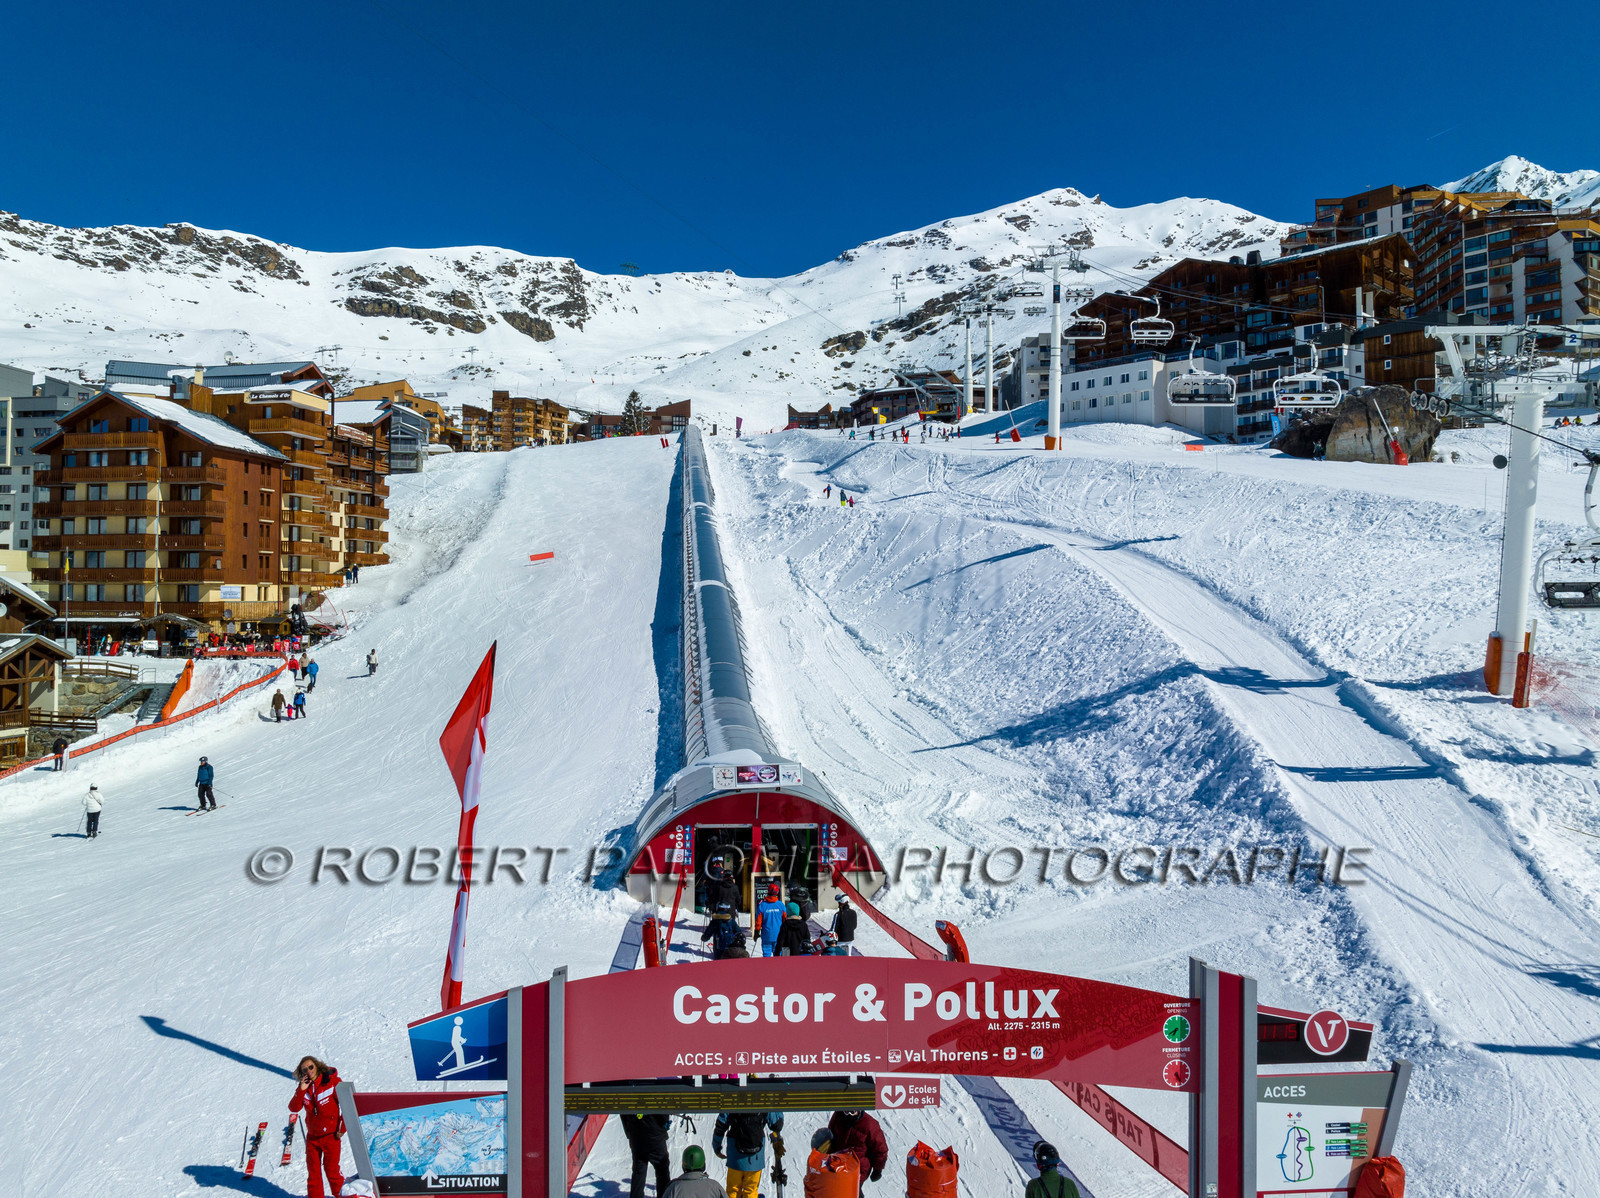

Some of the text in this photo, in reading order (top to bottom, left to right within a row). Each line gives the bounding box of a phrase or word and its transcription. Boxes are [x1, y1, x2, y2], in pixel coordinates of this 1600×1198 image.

[1569, 334, 1577, 343] 2
[673, 985, 837, 1025] Castor
[852, 983, 887, 1022] &
[904, 981, 1061, 1021] Pollux
[987, 1022, 1002, 1031] Alt.
[1004, 1022, 1024, 1030] 2275
[1031, 1021, 1051, 1030] 2315
[674, 1052, 724, 1066] ACCES
[751, 1052, 788, 1065] Piste
[791, 1054, 818, 1065] aux
[822, 1047, 871, 1064] Étoiles
[904, 1049, 927, 1062] Val
[930, 1049, 989, 1062] Thorens
[908, 1084, 938, 1094] Ecoles
[1263, 1085, 1306, 1098] ACCES
[908, 1095, 935, 1105] de ski
[439, 1177, 499, 1188] SITUATION
